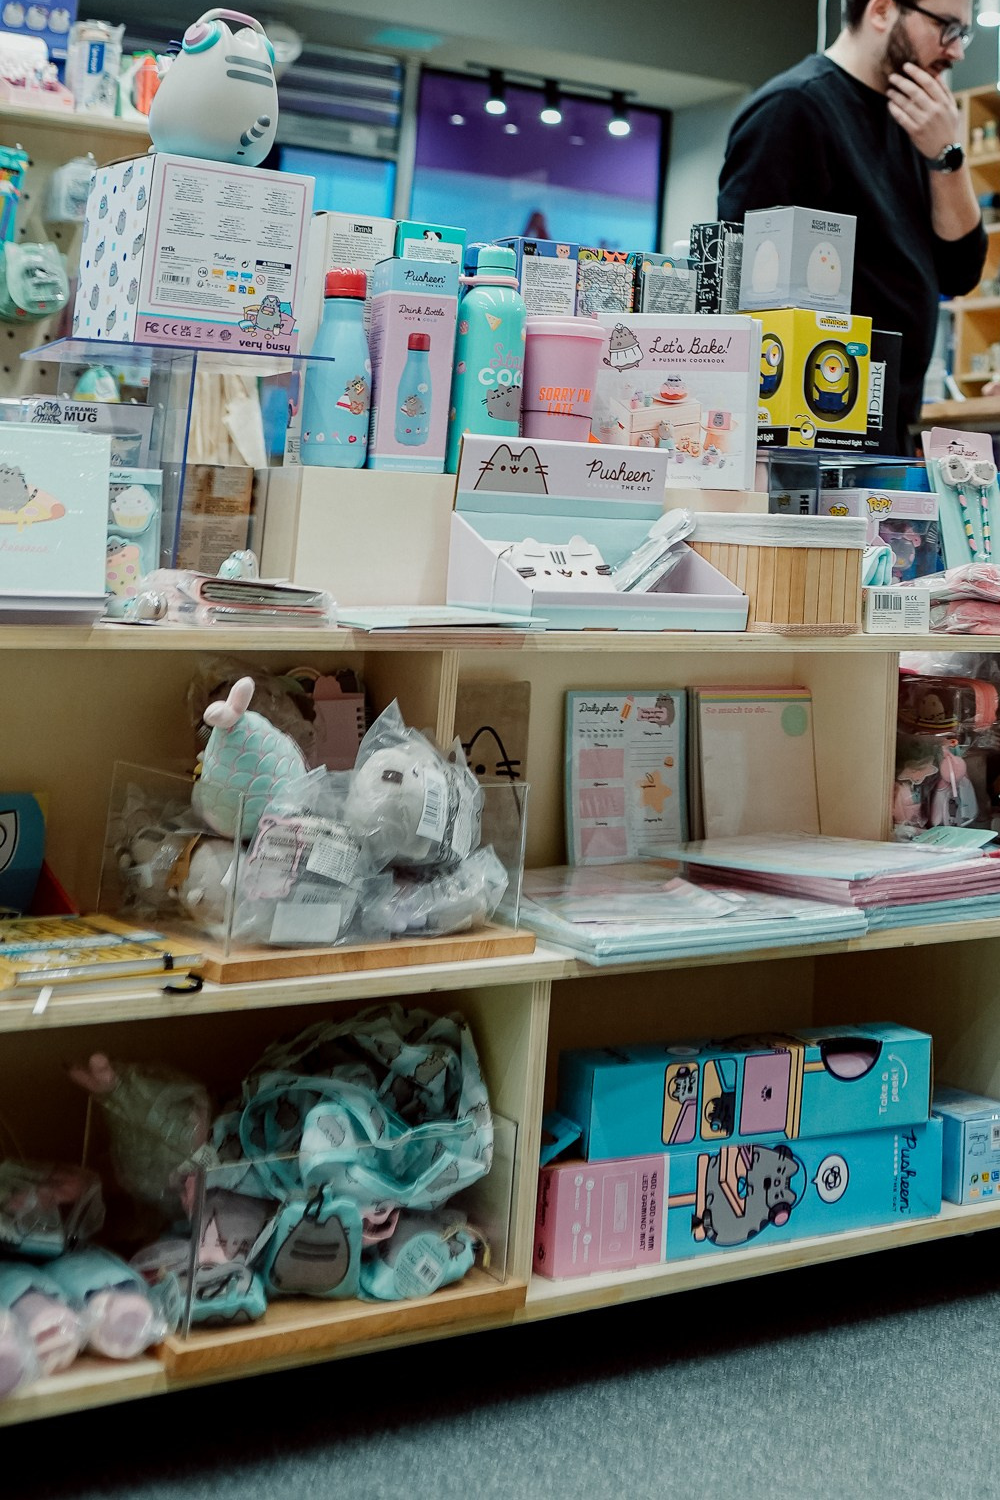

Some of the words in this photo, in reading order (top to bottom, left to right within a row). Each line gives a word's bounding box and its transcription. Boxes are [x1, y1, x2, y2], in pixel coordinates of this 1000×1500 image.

[404, 270, 446, 283] Pusheen
[399, 305, 422, 314] Drink
[424, 307, 445, 316] Bottle
[820, 318, 848, 326] minions
[239, 340, 262, 351] very
[266, 341, 290, 354] busy
[649, 336, 685, 354] Let's
[688, 336, 732, 354] Bake!
[539, 386, 576, 401] SORRY
[577, 388, 592, 402] I'M
[547, 402, 574, 416] LATE
[64, 412, 97, 422] MUG
[764, 433, 774, 442] light
[947, 446, 978, 457] Pusheen
[586, 458, 654, 483] Pusheen
[866, 497, 892, 513] POP!
[579, 702, 600, 714] Daily
[600, 703, 618, 715] plan
[705, 706, 716, 714] So
[718, 706, 742, 714] much
[882, 1072, 888, 1081] a
[891, 1068, 900, 1102] peek!
[878, 1084, 888, 1116] Take
[900, 1128, 917, 1214] Pusheen
[640, 1194, 648, 1230] GAMING
